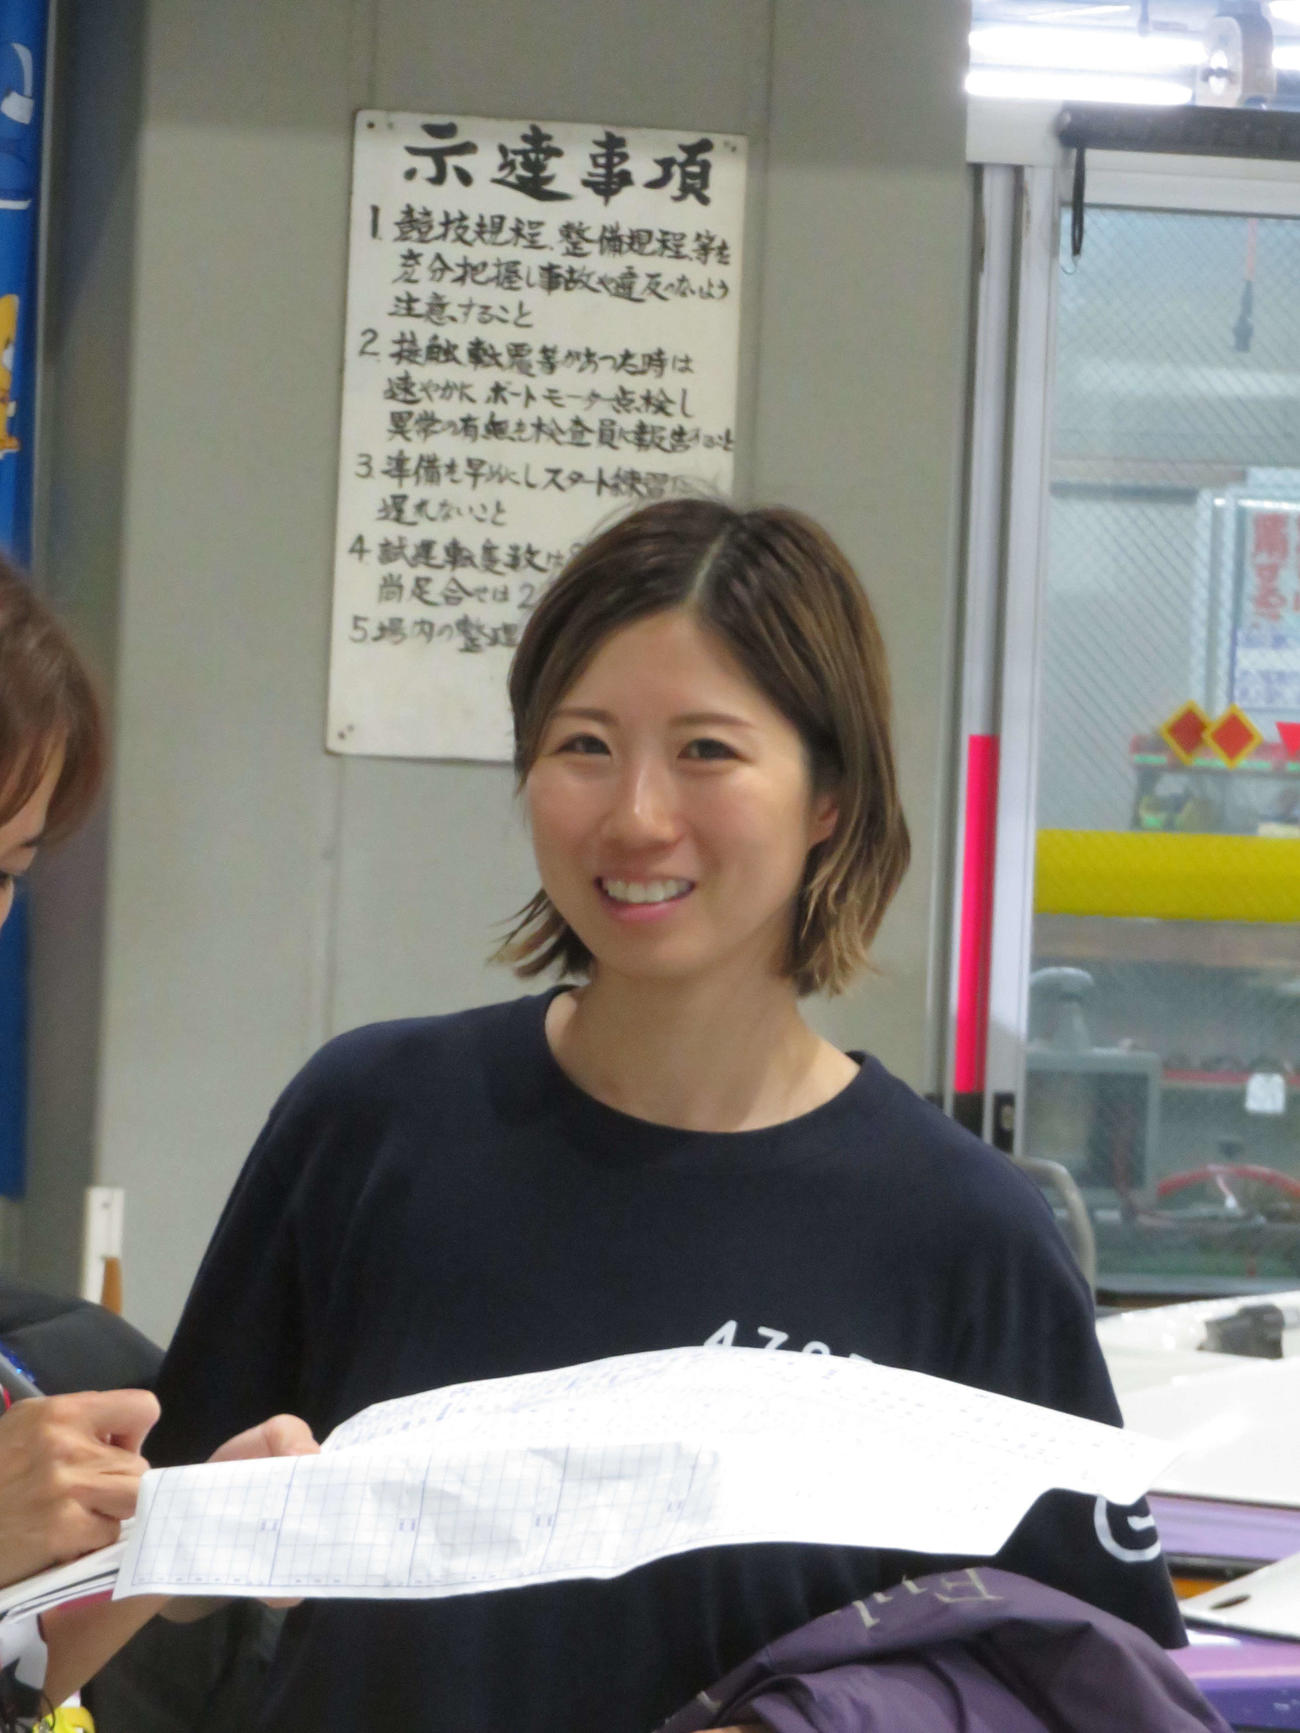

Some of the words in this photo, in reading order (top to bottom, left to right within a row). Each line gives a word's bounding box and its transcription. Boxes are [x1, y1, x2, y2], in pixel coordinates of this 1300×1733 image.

[403, 122, 716, 207] 示達事項
[388, 290, 533, 328] 注意すること
[376, 493, 507, 527] 遅れないこと
